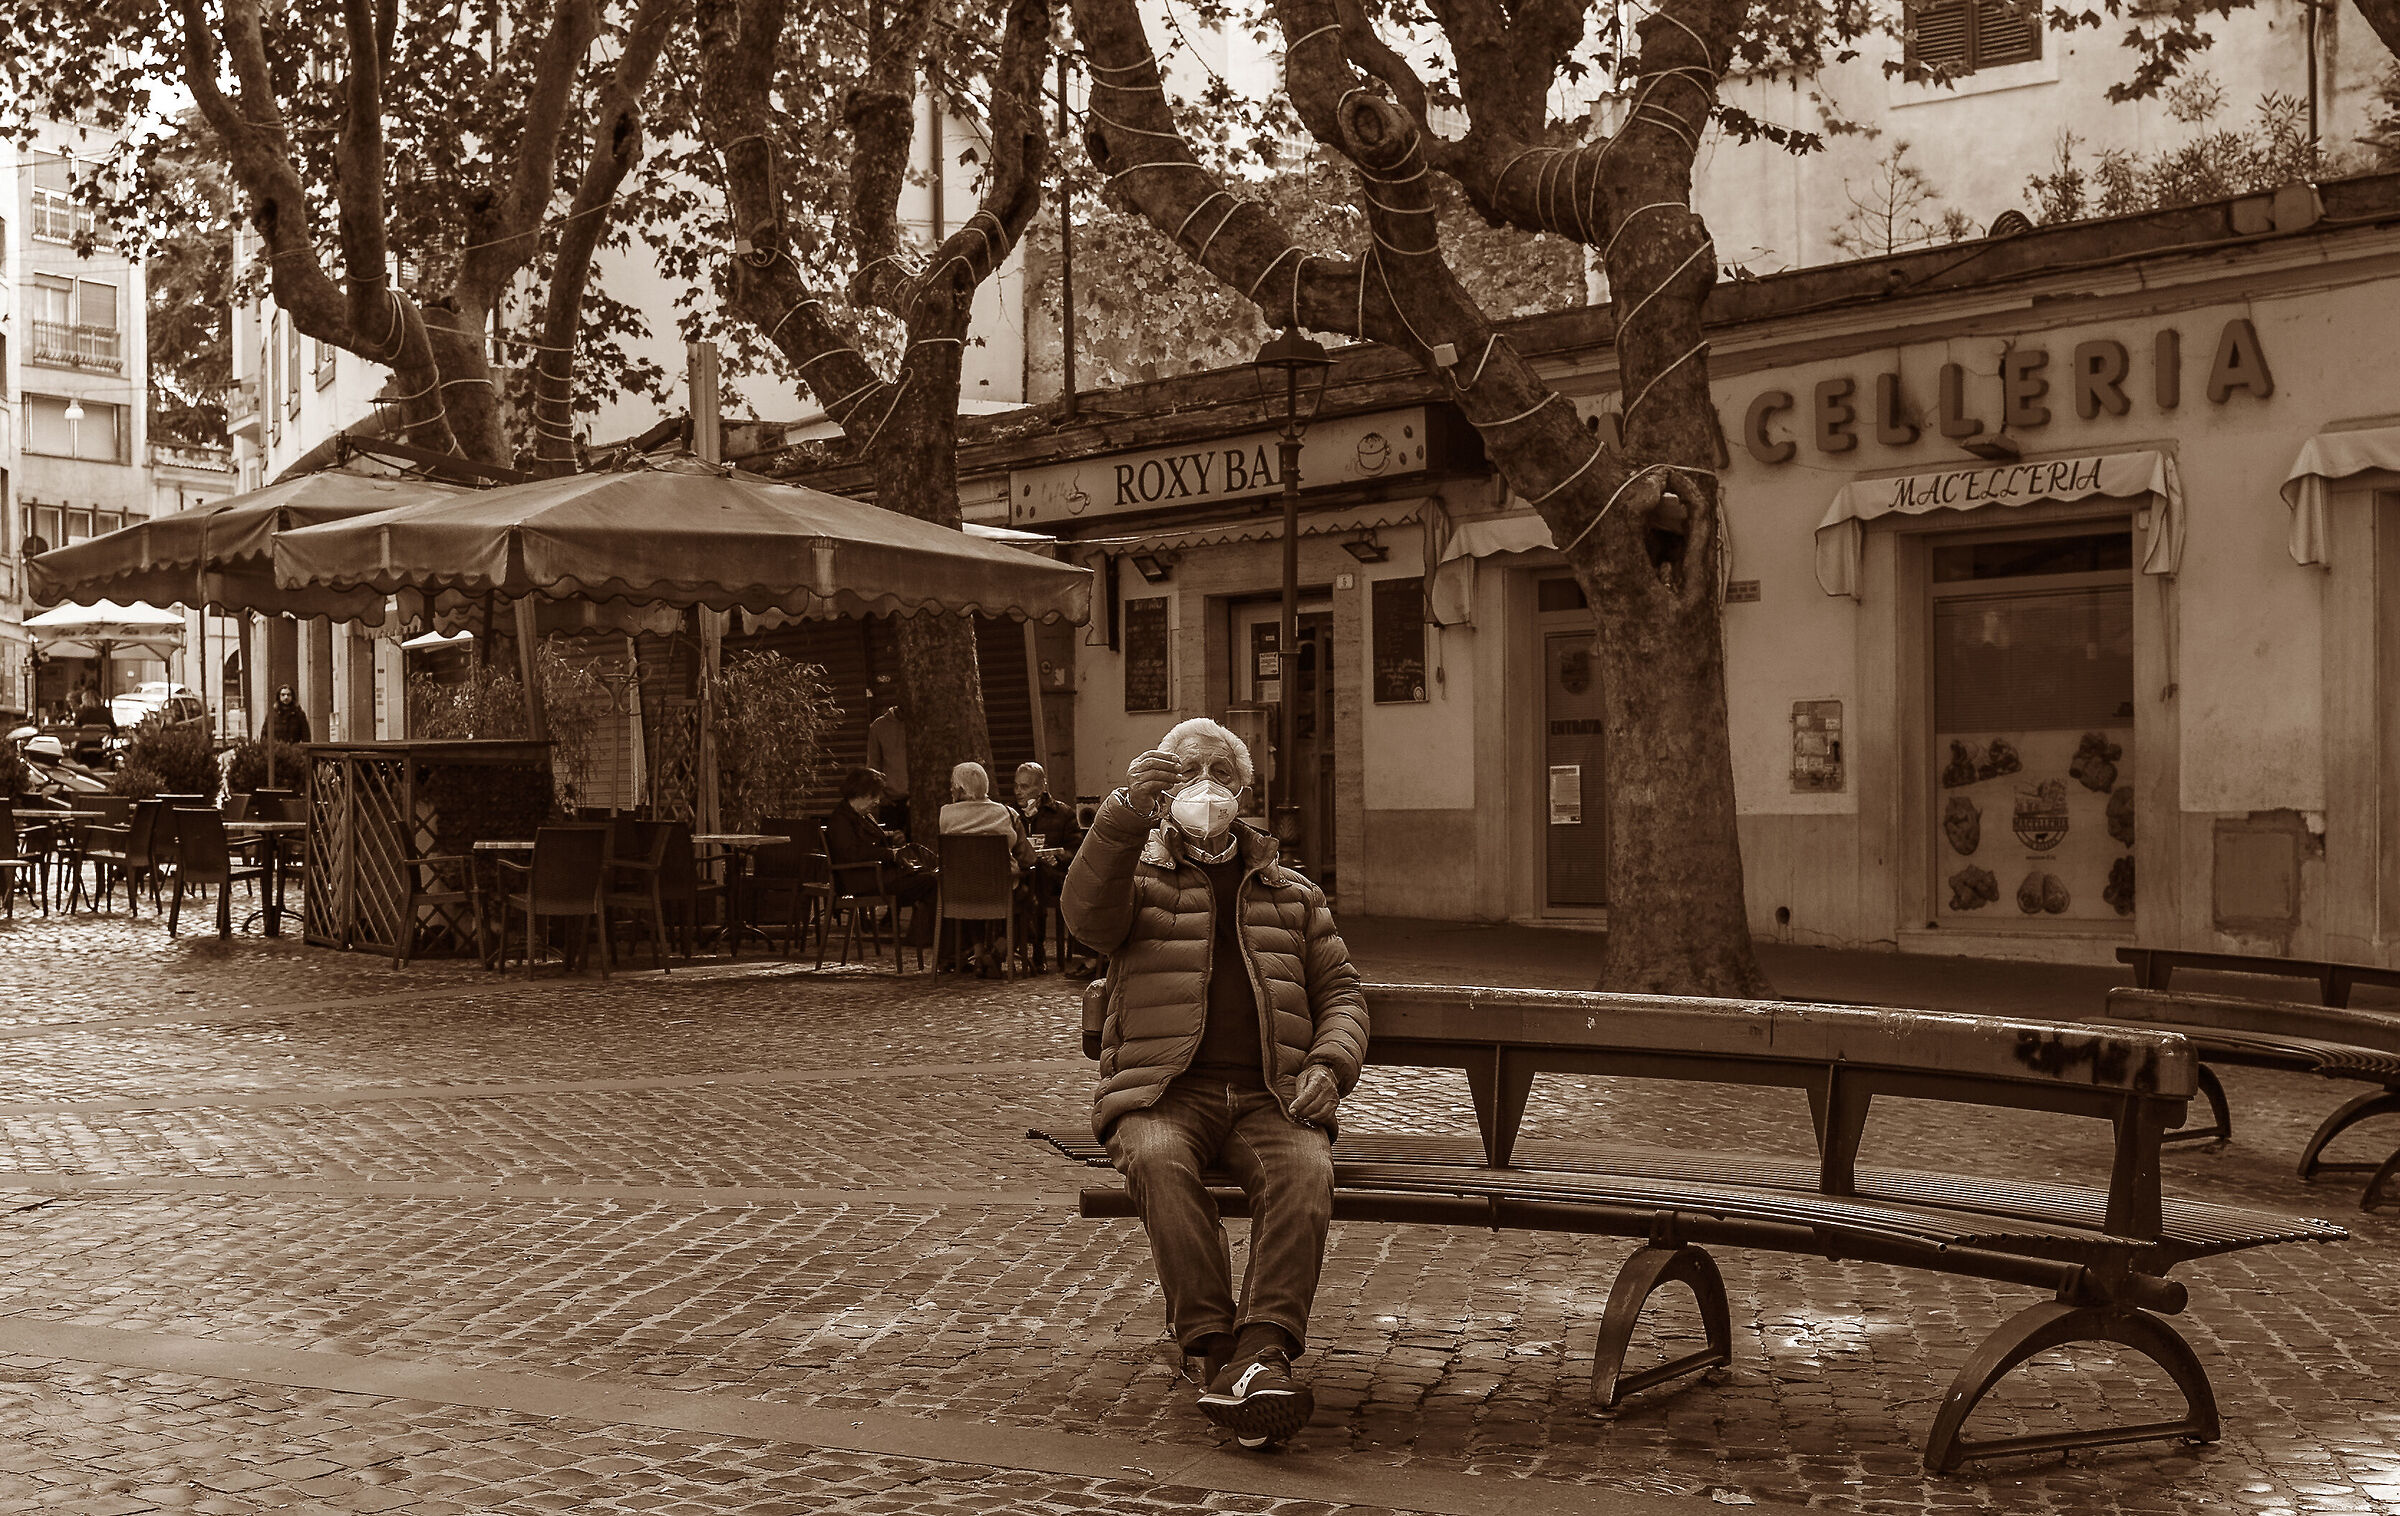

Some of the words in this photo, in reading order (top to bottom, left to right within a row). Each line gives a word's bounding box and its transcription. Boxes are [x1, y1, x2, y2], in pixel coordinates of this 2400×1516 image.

[1605, 318, 2275, 471] CELLERIA
[1113, 450, 1216, 506] ROXY
[1887, 457, 2103, 509] MACELLERIA
